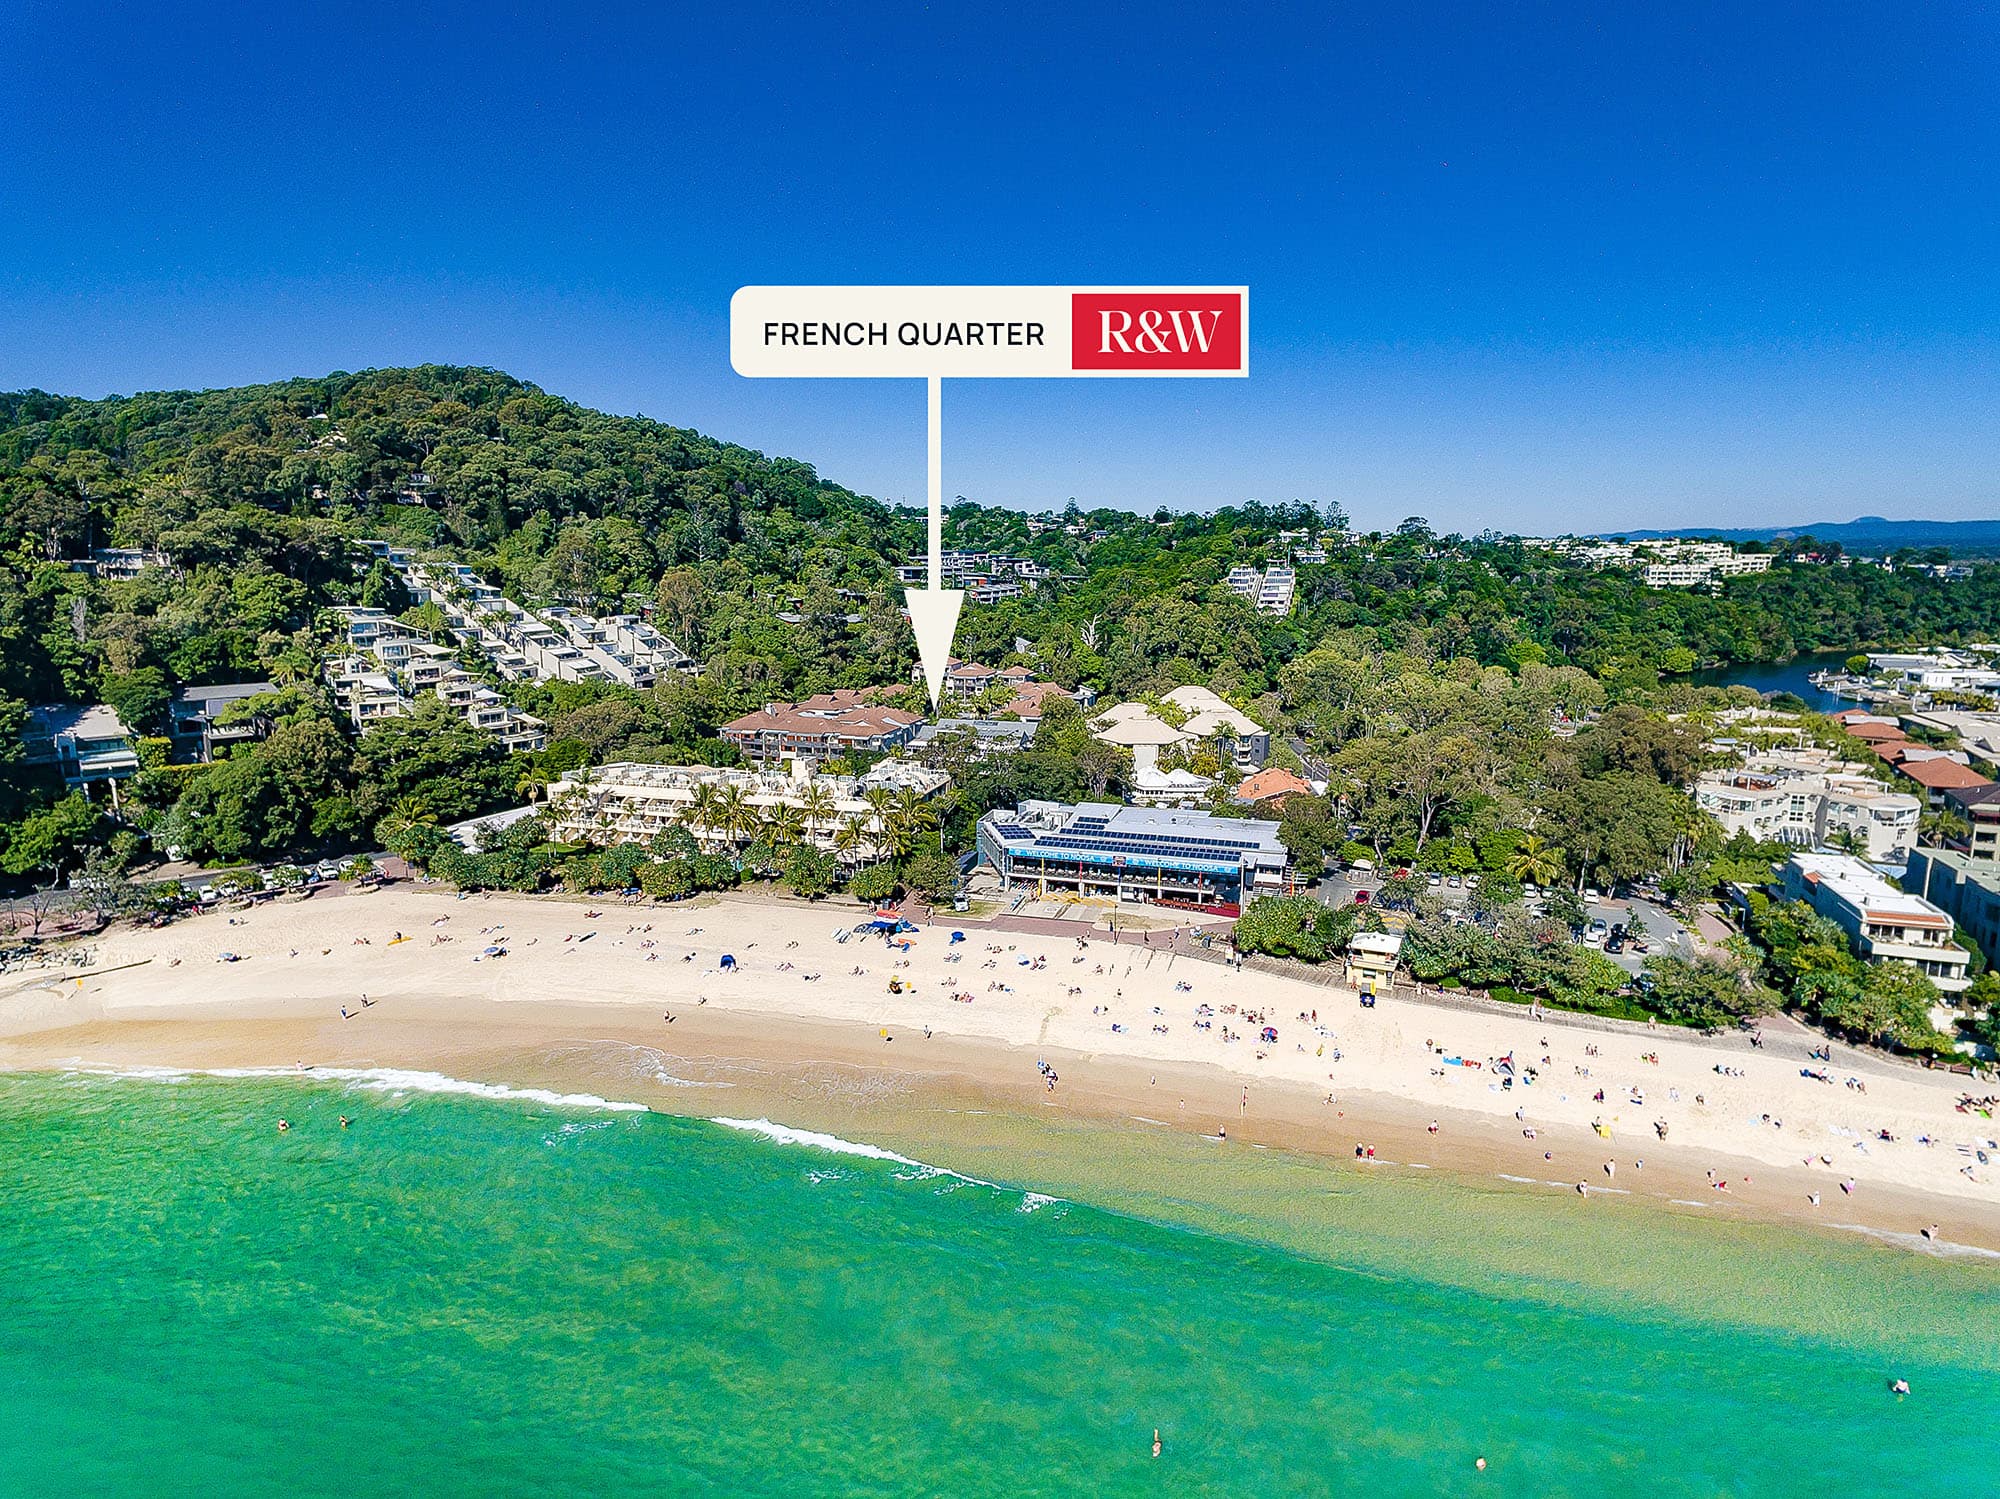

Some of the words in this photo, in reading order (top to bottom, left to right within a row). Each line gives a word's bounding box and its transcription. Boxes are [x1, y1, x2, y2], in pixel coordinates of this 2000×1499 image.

[1026, 849, 1059, 859] WELCOME
[1071, 853, 1095, 861] NOOSA
[1145, 860, 1179, 868] WELCOME
[1192, 864, 1219, 872] NOOSA
